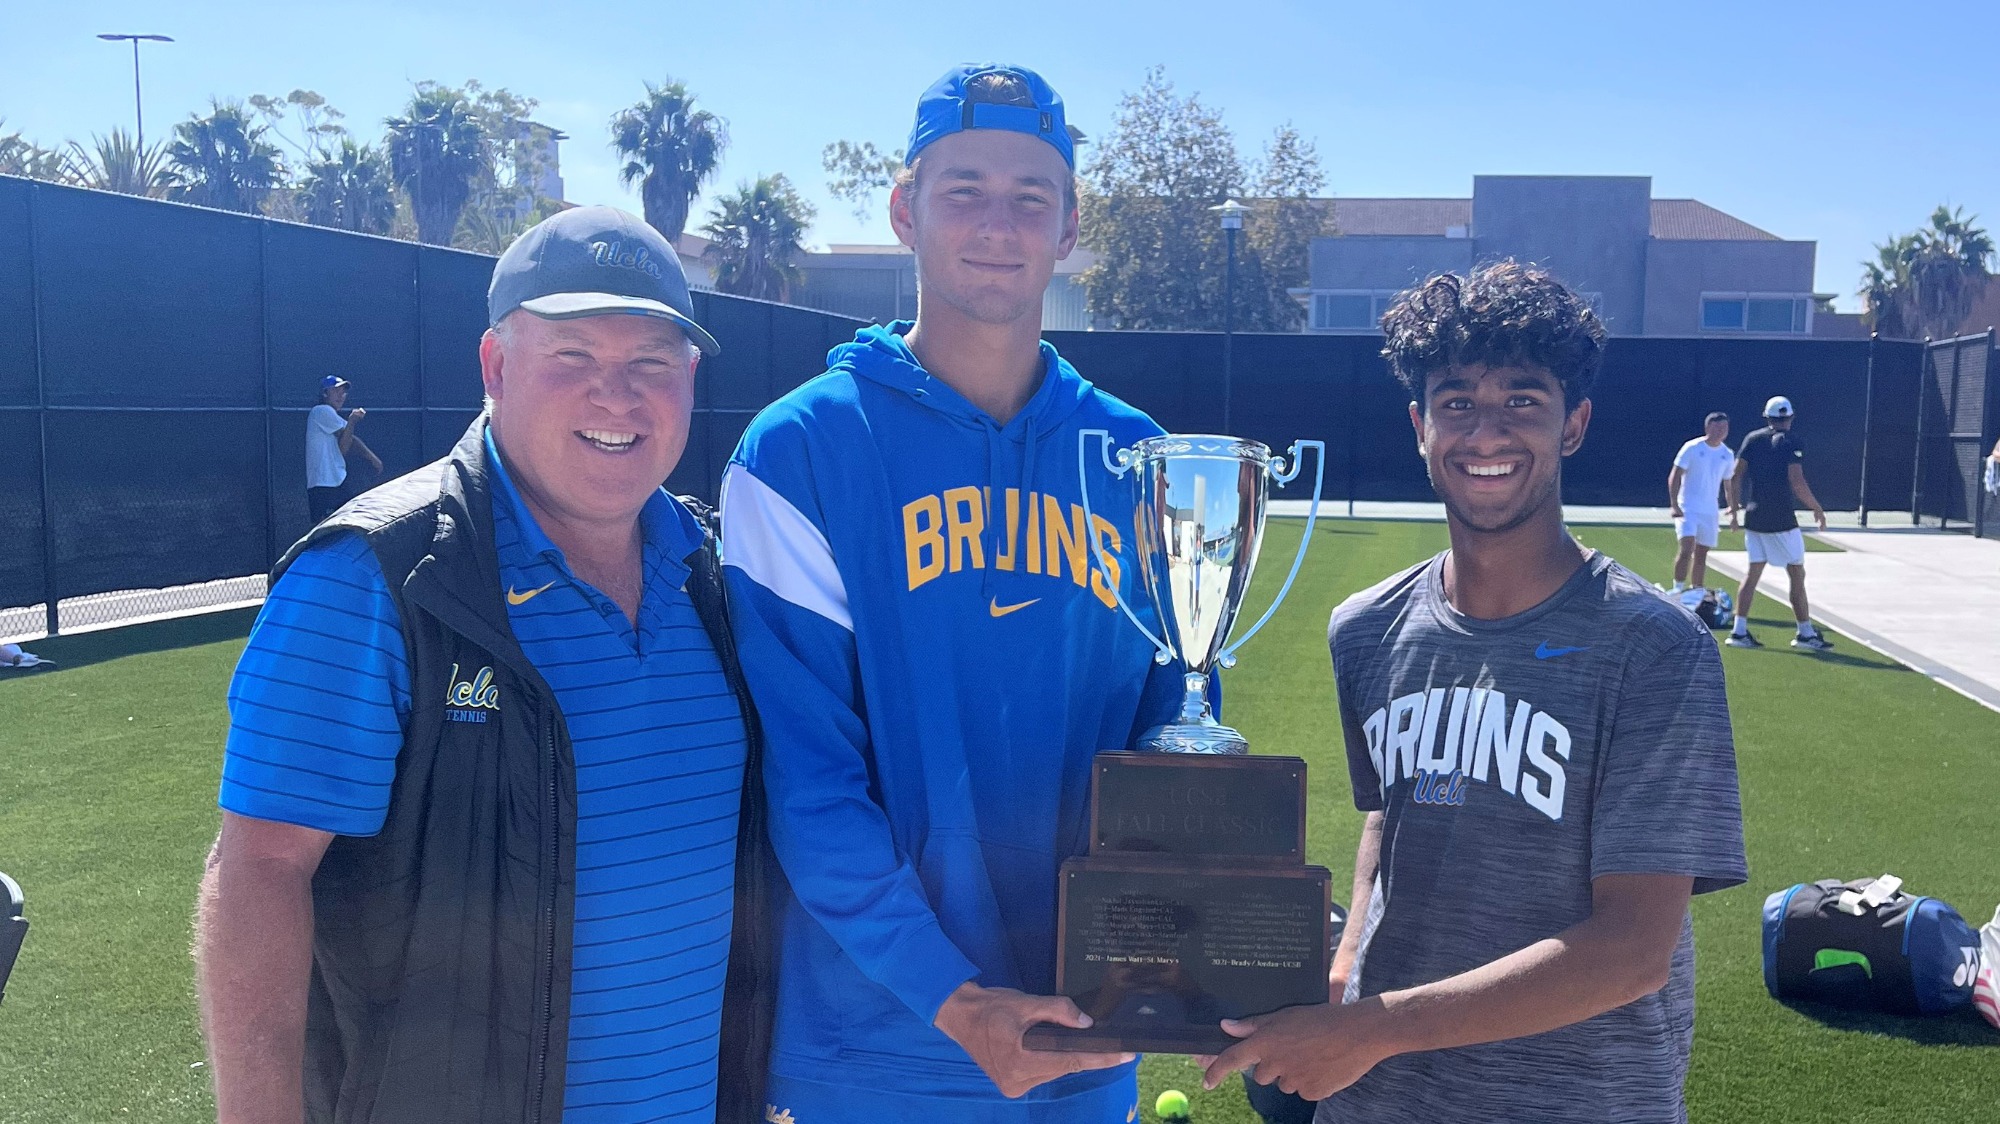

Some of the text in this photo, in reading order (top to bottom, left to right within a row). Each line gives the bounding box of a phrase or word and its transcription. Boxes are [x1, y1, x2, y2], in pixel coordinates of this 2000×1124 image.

[902, 486, 1121, 609] BRUINS
[446, 710, 487, 723] TENNIS
[1362, 686, 1572, 821] BRUINS
